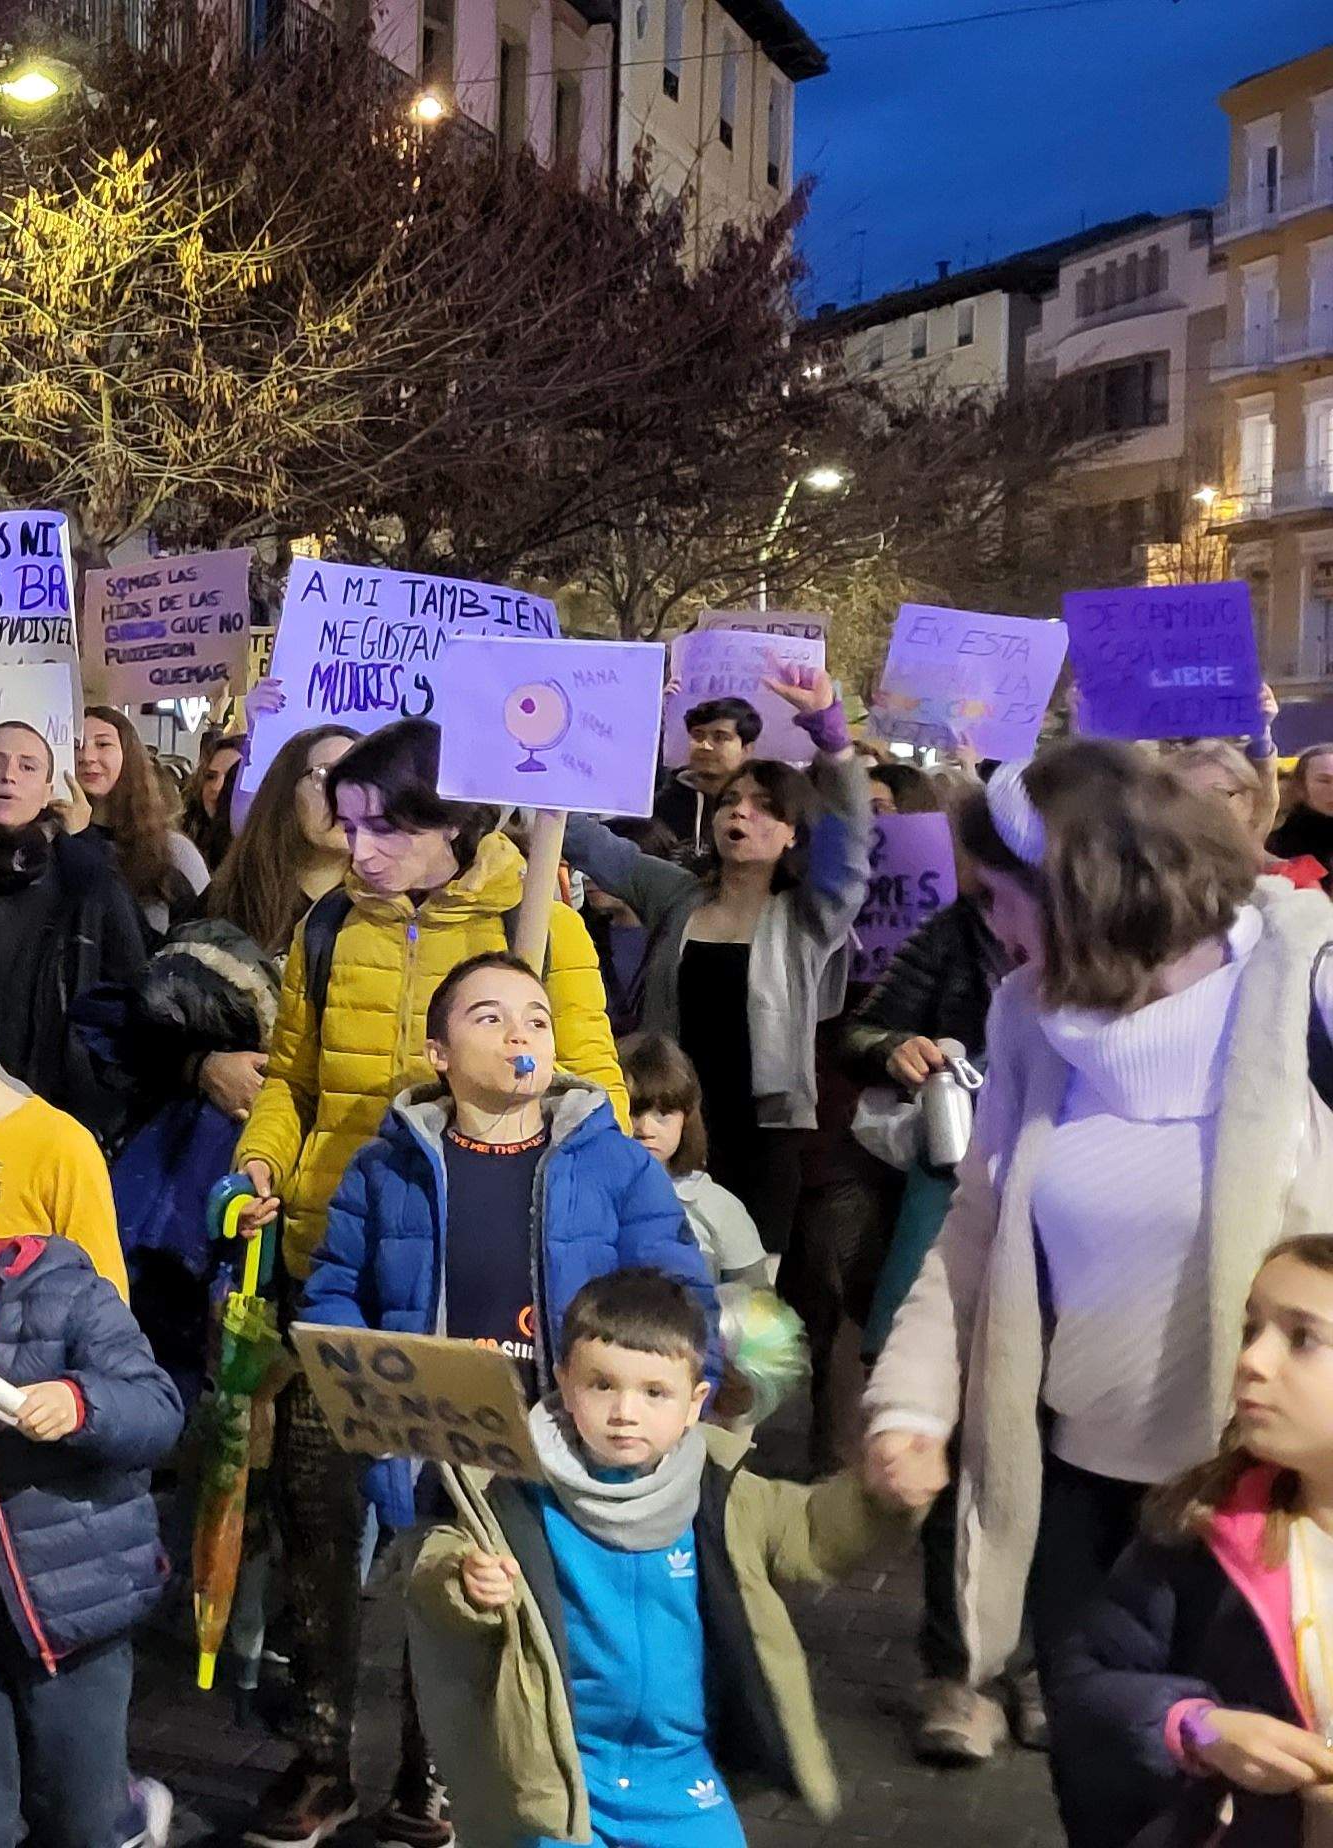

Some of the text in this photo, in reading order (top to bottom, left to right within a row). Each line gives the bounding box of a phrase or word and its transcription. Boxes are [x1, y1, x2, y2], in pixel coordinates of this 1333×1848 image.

[105, 566, 199, 600] SOMOS LAS
[300, 570, 327, 602] A
[343, 576, 382, 607] MI
[159, 594, 184, 612] DE
[189, 590, 223, 608] LAS
[170, 615, 213, 634] QUE
[219, 612, 244, 634] NO
[956, 629, 1032, 664] ESTA
[149, 662, 231, 685] QUEMAR
[1148, 665, 1235, 689] LIBRE
[317, 1340, 416, 1384] NO
[339, 1378, 509, 1434] TENGO
